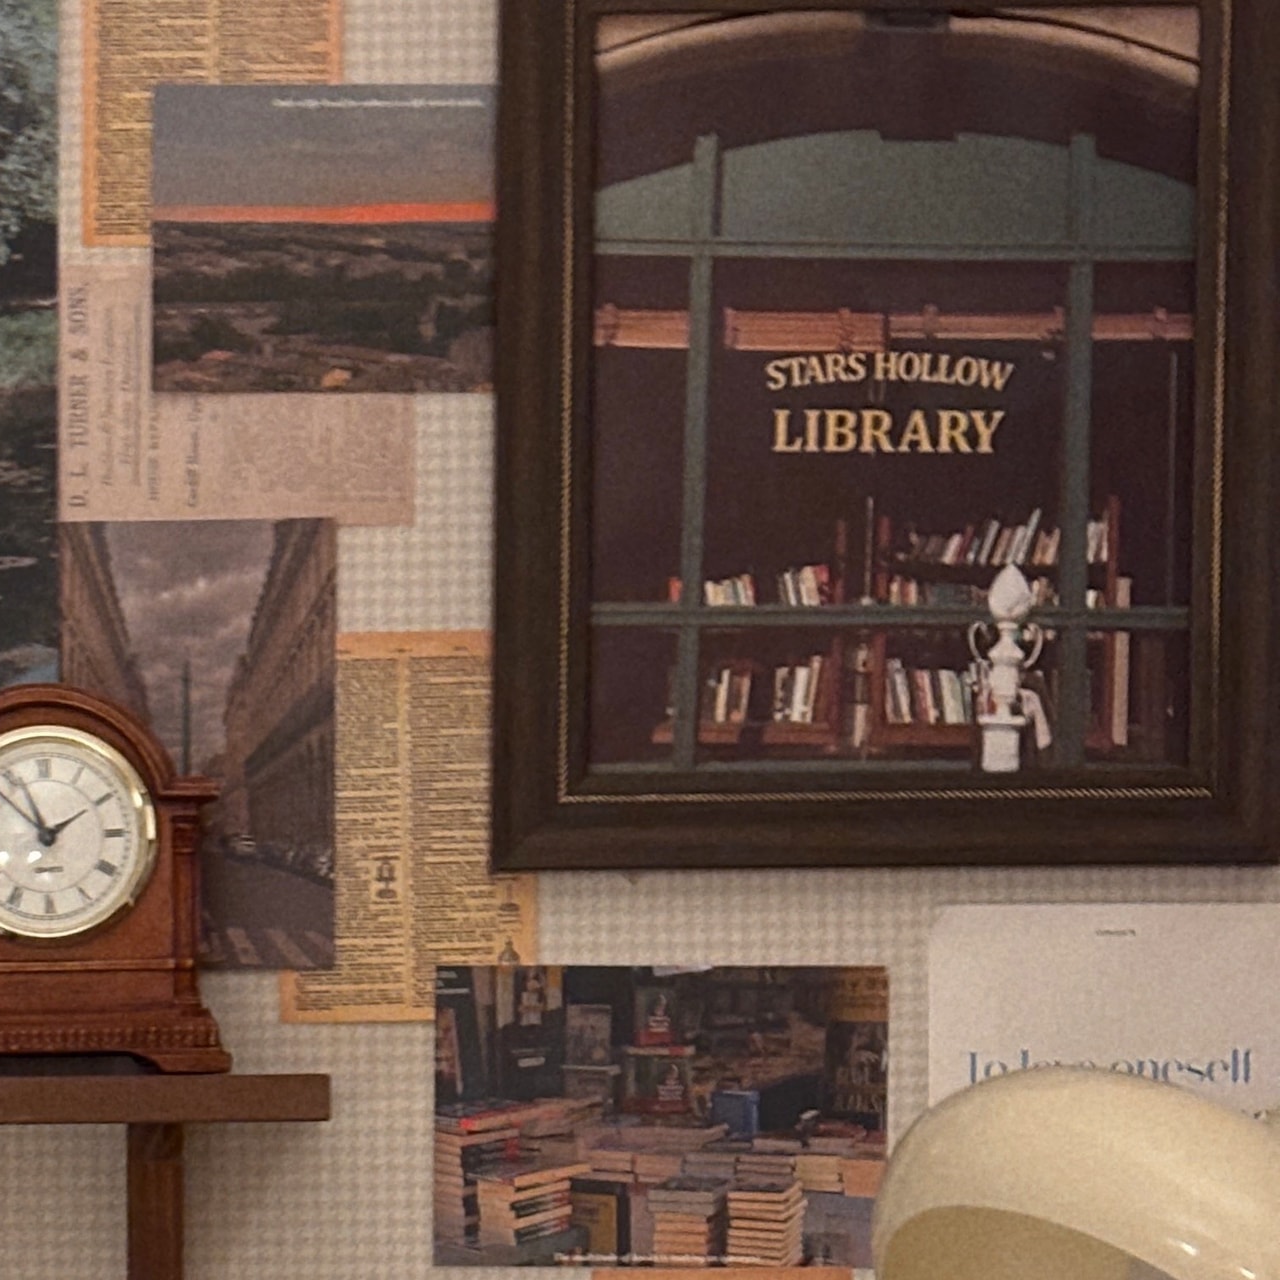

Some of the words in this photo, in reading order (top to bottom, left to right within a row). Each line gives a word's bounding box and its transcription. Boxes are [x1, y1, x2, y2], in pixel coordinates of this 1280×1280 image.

[765, 352, 867, 391] STARS
[873, 351, 1015, 392] HOLLOW
[67, 376, 89, 448] TURNER
[772, 408, 1006, 454] LIBRARY
